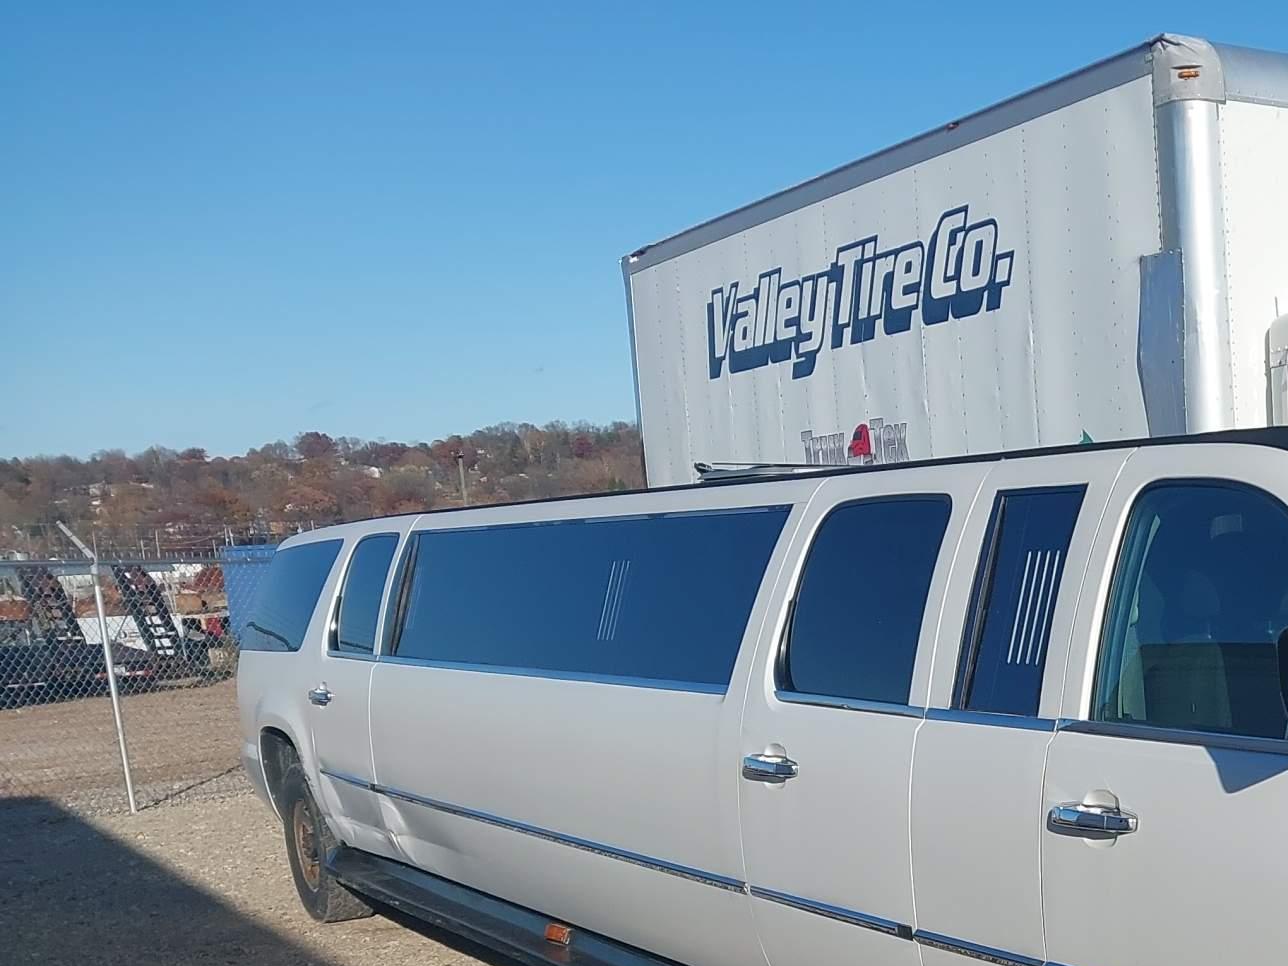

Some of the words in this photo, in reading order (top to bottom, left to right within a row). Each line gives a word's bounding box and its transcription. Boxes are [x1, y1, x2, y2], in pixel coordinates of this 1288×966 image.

[707, 266, 830, 380] Valley
[830, 235, 925, 350] Tire
[921, 204, 1015, 327] Co.
